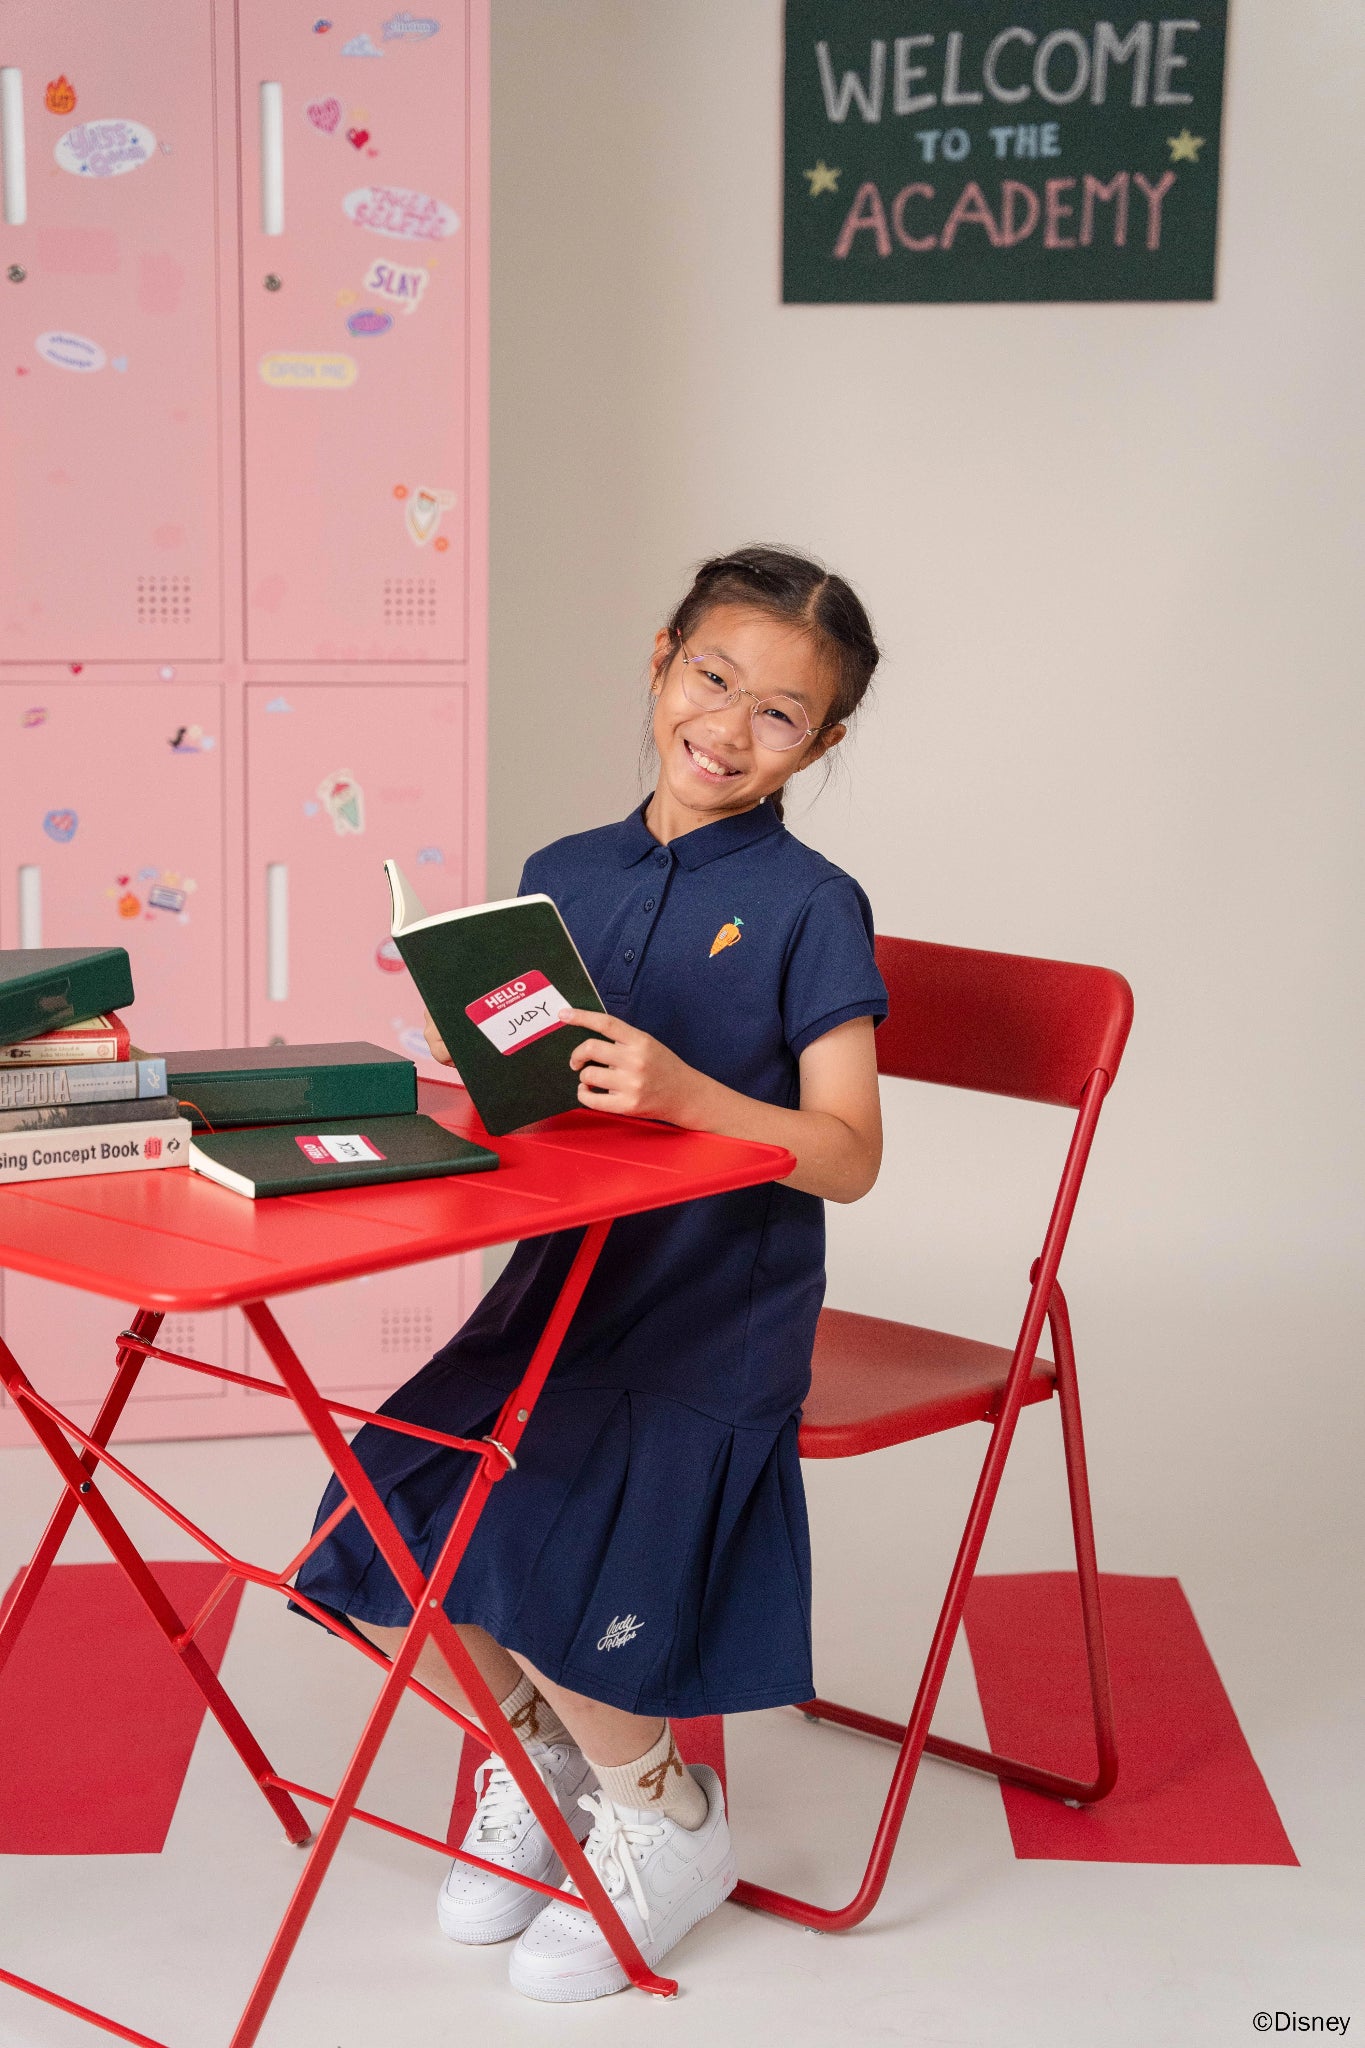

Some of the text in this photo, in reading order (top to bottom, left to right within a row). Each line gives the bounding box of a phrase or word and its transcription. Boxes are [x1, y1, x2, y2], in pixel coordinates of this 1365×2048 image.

[815, 19, 1200, 123] WELCOME
[915, 122, 1062, 163] TO THE
[833, 170, 1177, 259] ACADEMY
[369, 265, 421, 298] SLAY
[484, 981, 527, 1009] HELLO
[508, 1001, 551, 1036] JUDY
[32, 1144, 97, 1166] Concept
[100, 1140, 140, 1160] Book
